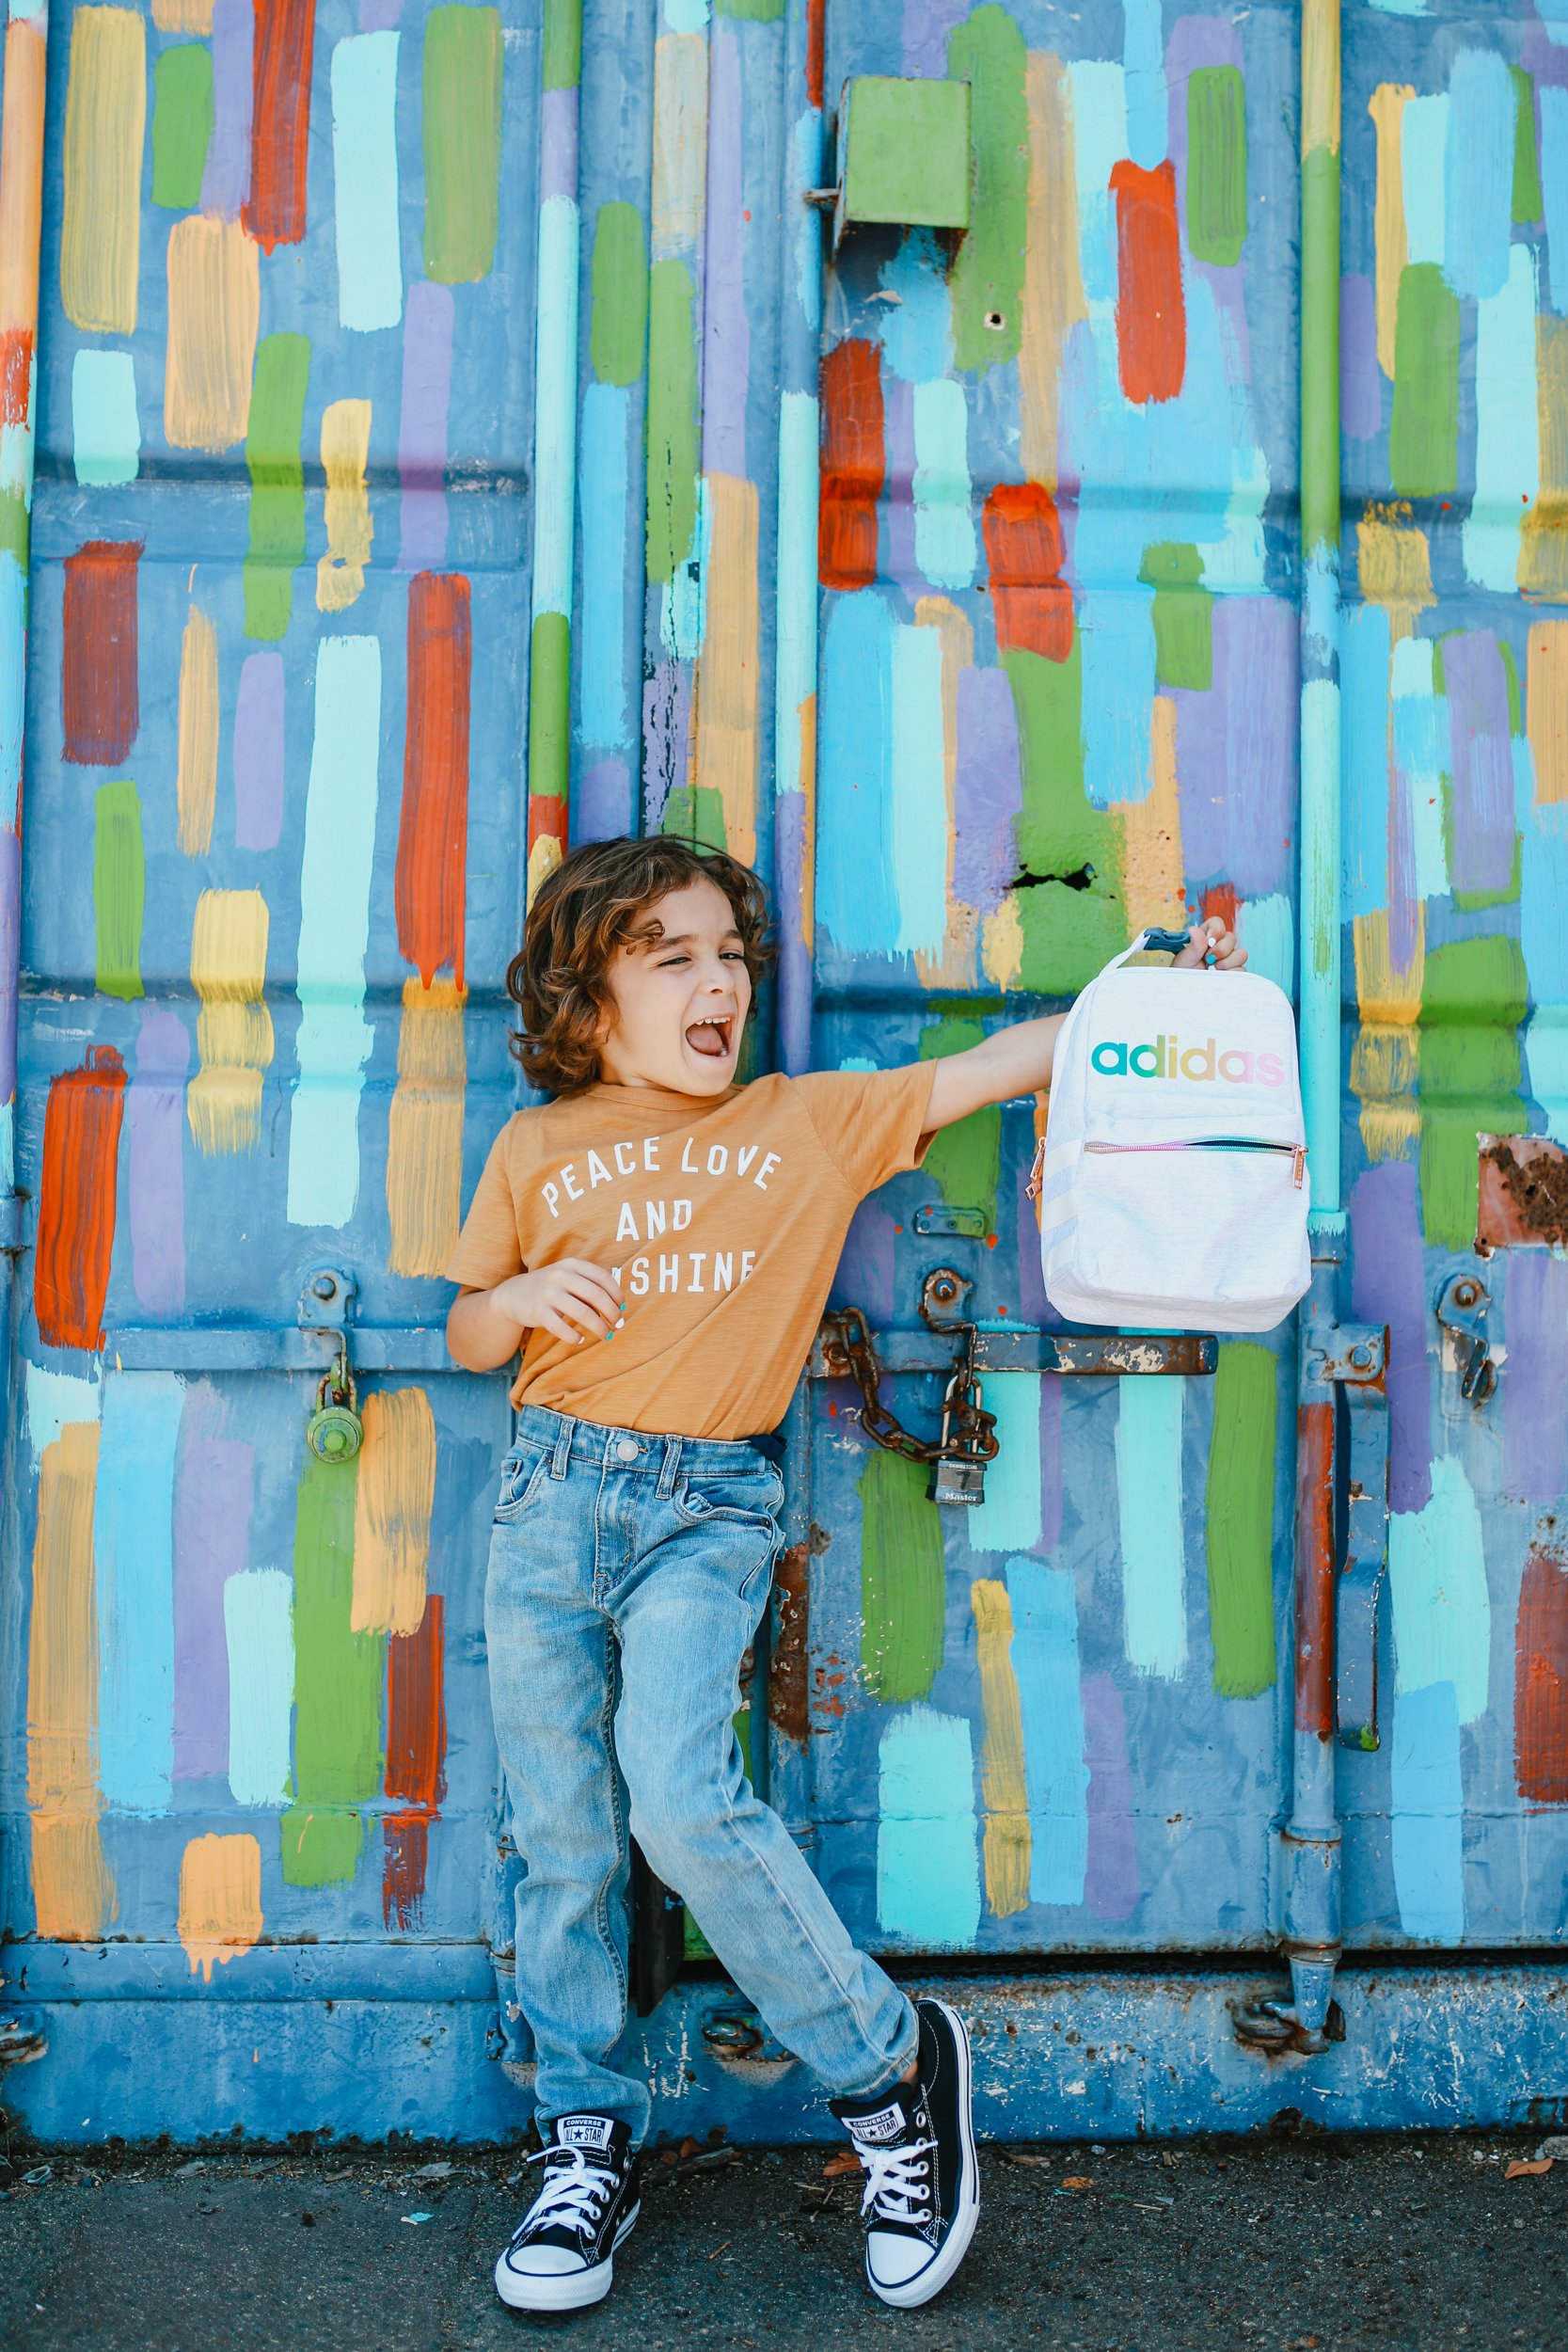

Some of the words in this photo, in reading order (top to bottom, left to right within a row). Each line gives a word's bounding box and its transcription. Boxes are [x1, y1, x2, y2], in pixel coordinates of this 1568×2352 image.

[1091, 1034, 1285, 1087] adidas
[541, 1136, 660, 1218] PEACE
[681, 1136, 782, 1190] LOVE
[616, 1199, 692, 1242] AND
[944, 1492, 978, 1502] Master
[853, 2113, 891, 2127] CONVERSE
[878, 2119, 896, 2137] STAR
[584, 2127, 602, 2143] STAR
